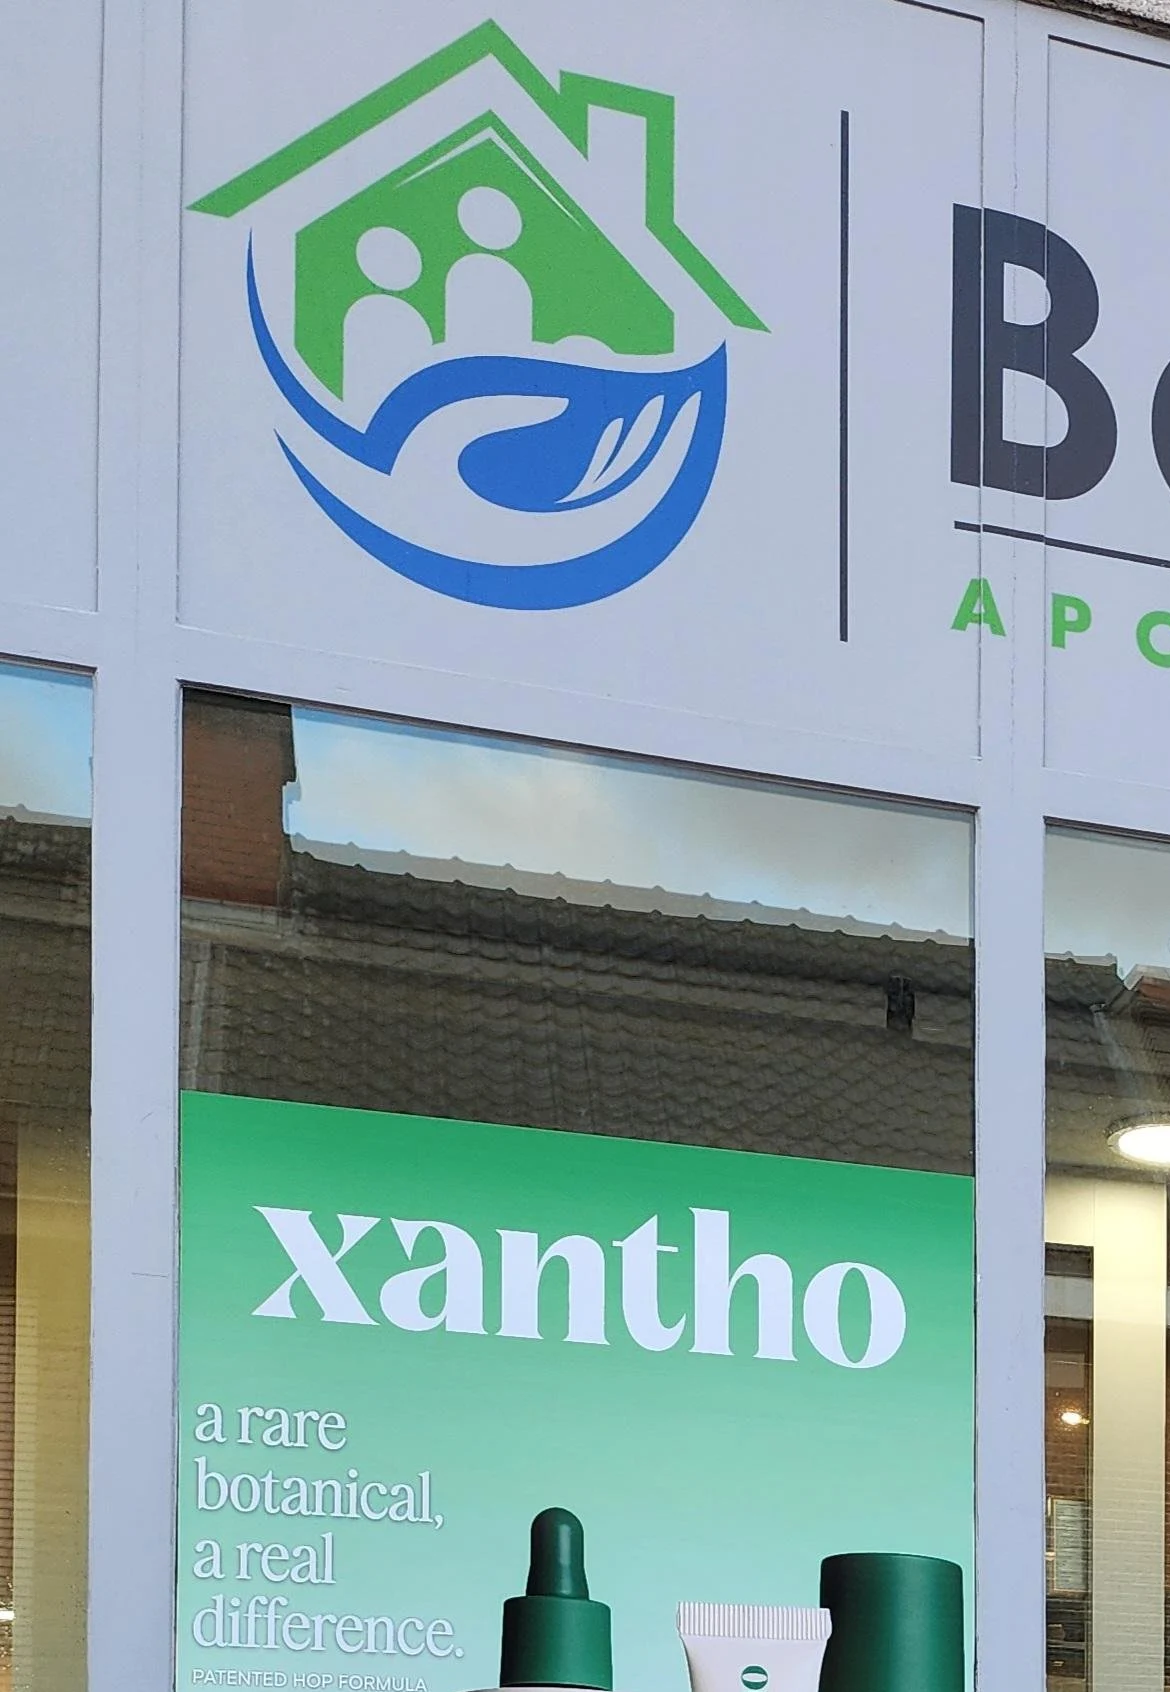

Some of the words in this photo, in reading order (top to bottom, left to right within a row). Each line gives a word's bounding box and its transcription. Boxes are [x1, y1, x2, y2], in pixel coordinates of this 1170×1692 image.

[251, 1205, 907, 1369] xantho
[194, 1403, 227, 1443] a
[237, 1406, 347, 1450] rare
[194, 1456, 444, 1529] botanical,
[193, 1539, 225, 1579] a
[236, 1532, 336, 1584] real
[193, 1594, 464, 1658] difference.
[192, 1669, 287, 1687] PATENTED
[293, 1673, 333, 1689] HOP
[339, 1675, 428, 1692] FORMULA
